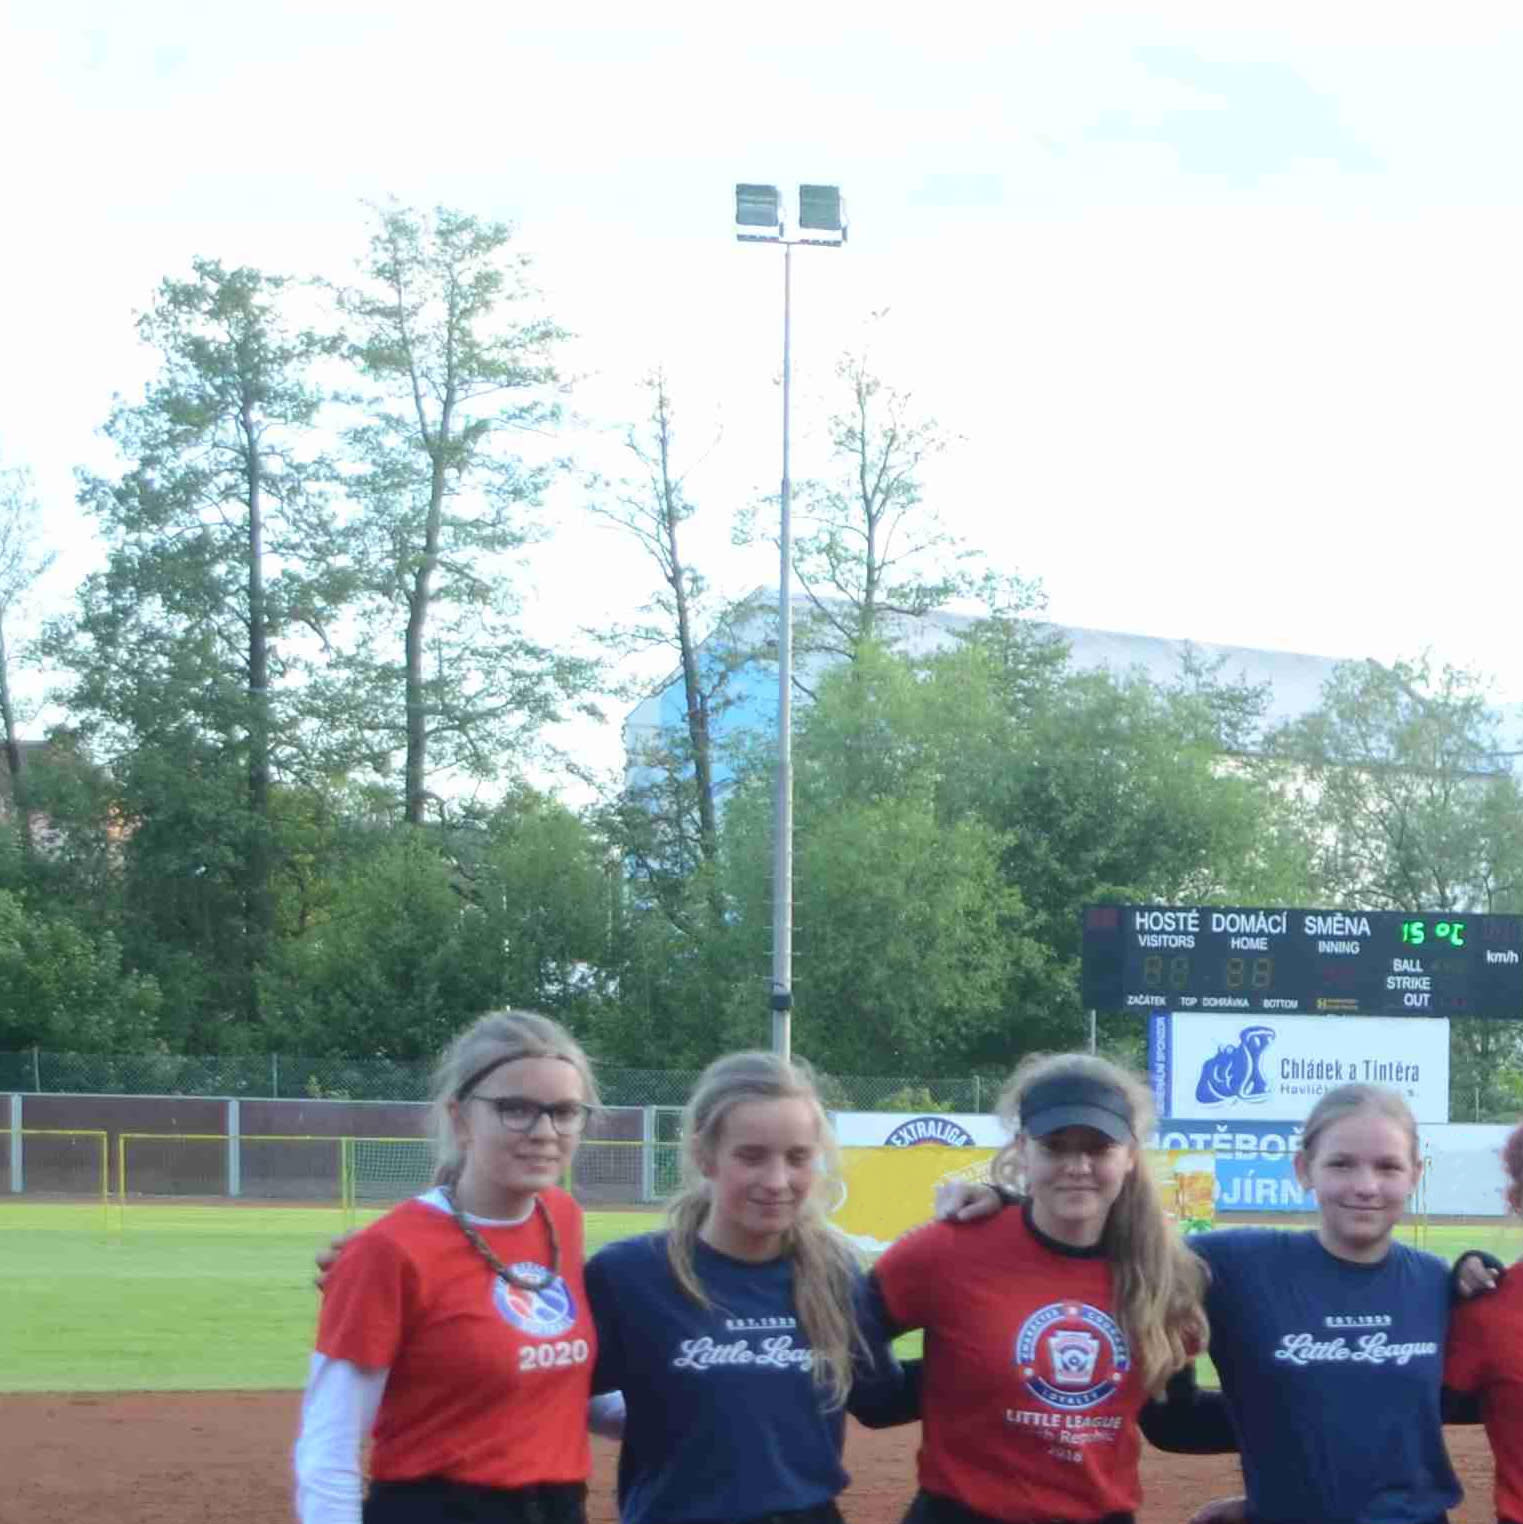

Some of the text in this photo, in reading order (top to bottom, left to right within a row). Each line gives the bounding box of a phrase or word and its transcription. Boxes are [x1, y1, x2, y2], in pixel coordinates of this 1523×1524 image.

[1135, 909, 1200, 932] HOSTÉ
[1211, 910, 1288, 934] DOMÁCÍ
[1304, 912, 1372, 937] SMĚNA
[1138, 934, 1196, 949] VISITORS
[1231, 937, 1268, 950] HOME
[1402, 921, 1425, 945] 15
[1318, 941, 1360, 955] INNING
[1486, 950, 1519, 964] km/h
[1393, 958, 1424, 973] BALL
[1387, 976, 1431, 991] STRIKE
[1181, 996, 1198, 1007] TOP
[1263, 998, 1298, 1009] BOTTOM
[1404, 993, 1431, 1008] OUT
[1280, 1058, 1420, 1083] Chládek a Tintěra
[890, 1119, 969, 1147] EXTRALIGA
[519, 1339, 588, 1371] 2020
[673, 1335, 813, 1372] Little Leag
[1275, 1332, 1437, 1365] Little League
[1006, 1408, 1123, 1430] LITTLE LEAGUE
